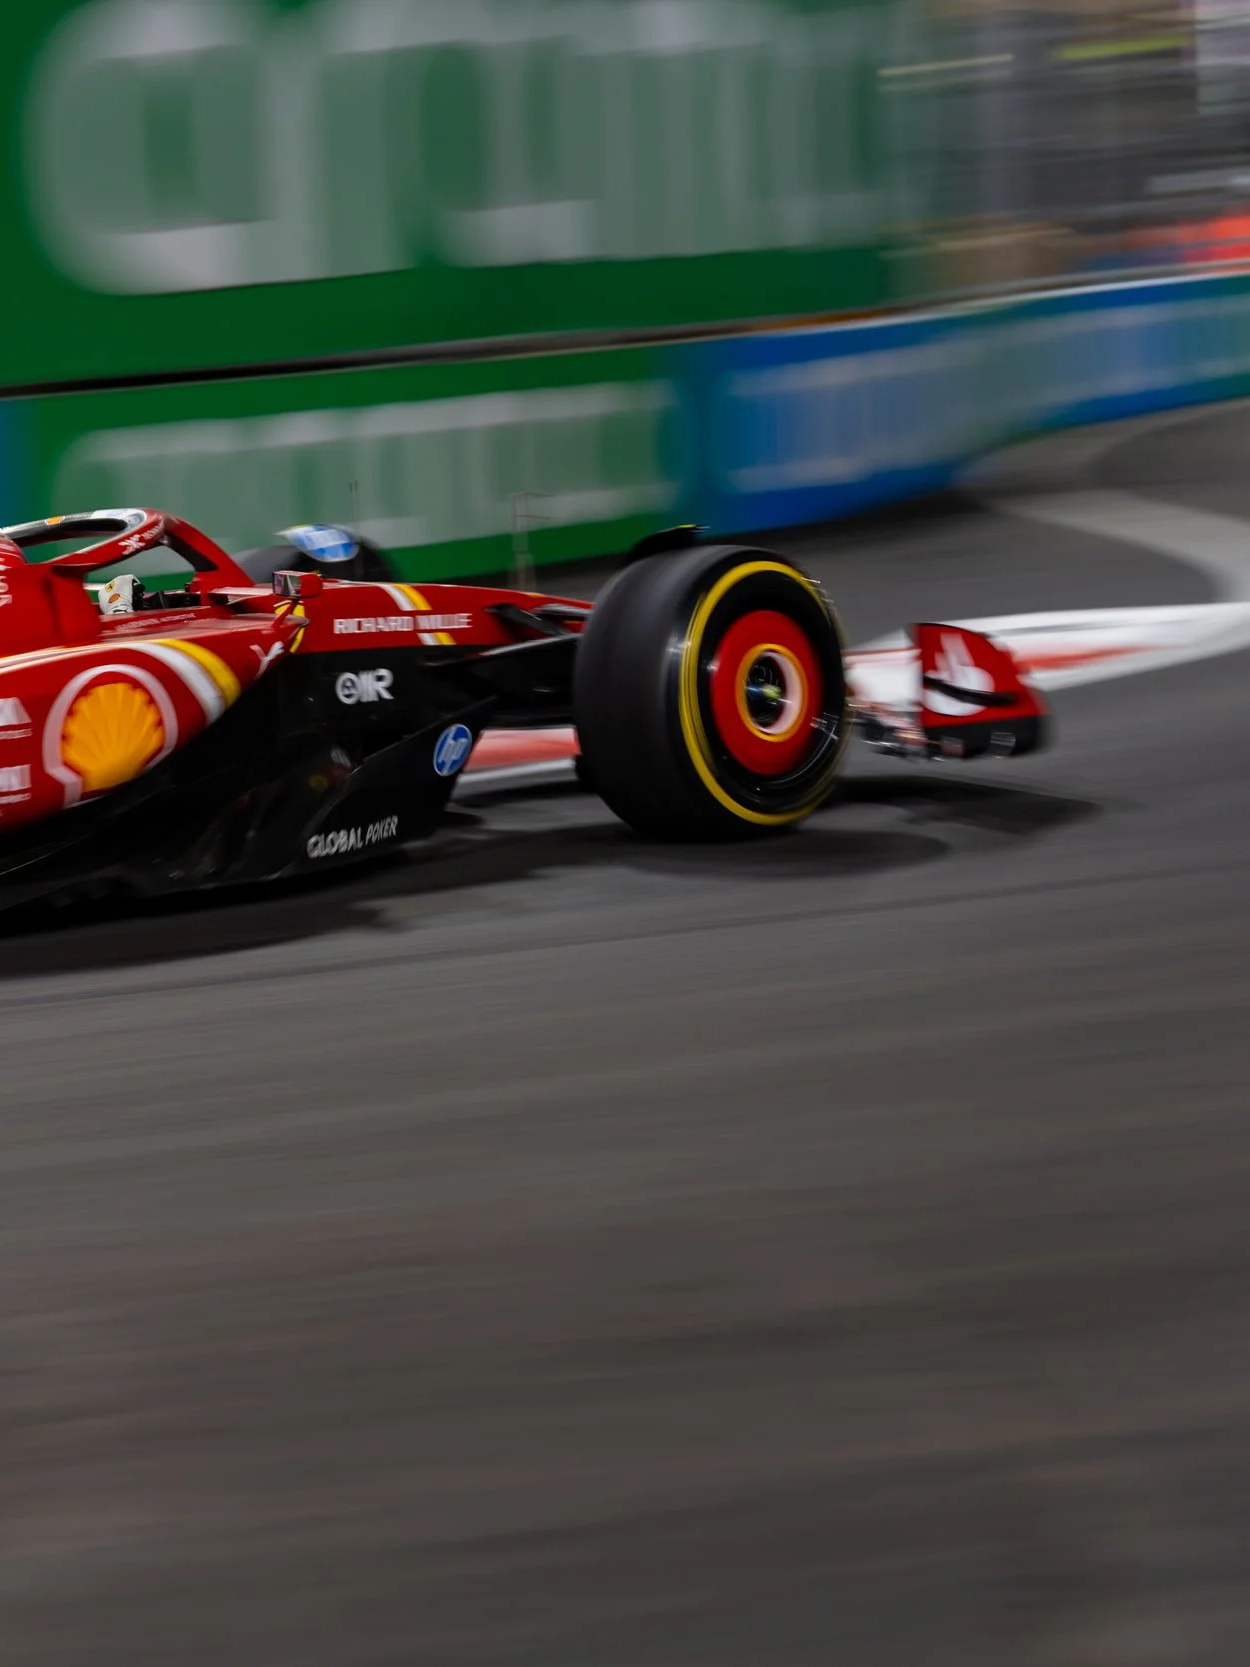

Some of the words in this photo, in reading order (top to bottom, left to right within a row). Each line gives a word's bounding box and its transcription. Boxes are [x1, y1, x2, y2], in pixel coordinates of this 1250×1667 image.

[333, 616, 414, 634] RICHARD
[306, 826, 364, 859] GLOBAL
[365, 815, 399, 846] POKER
